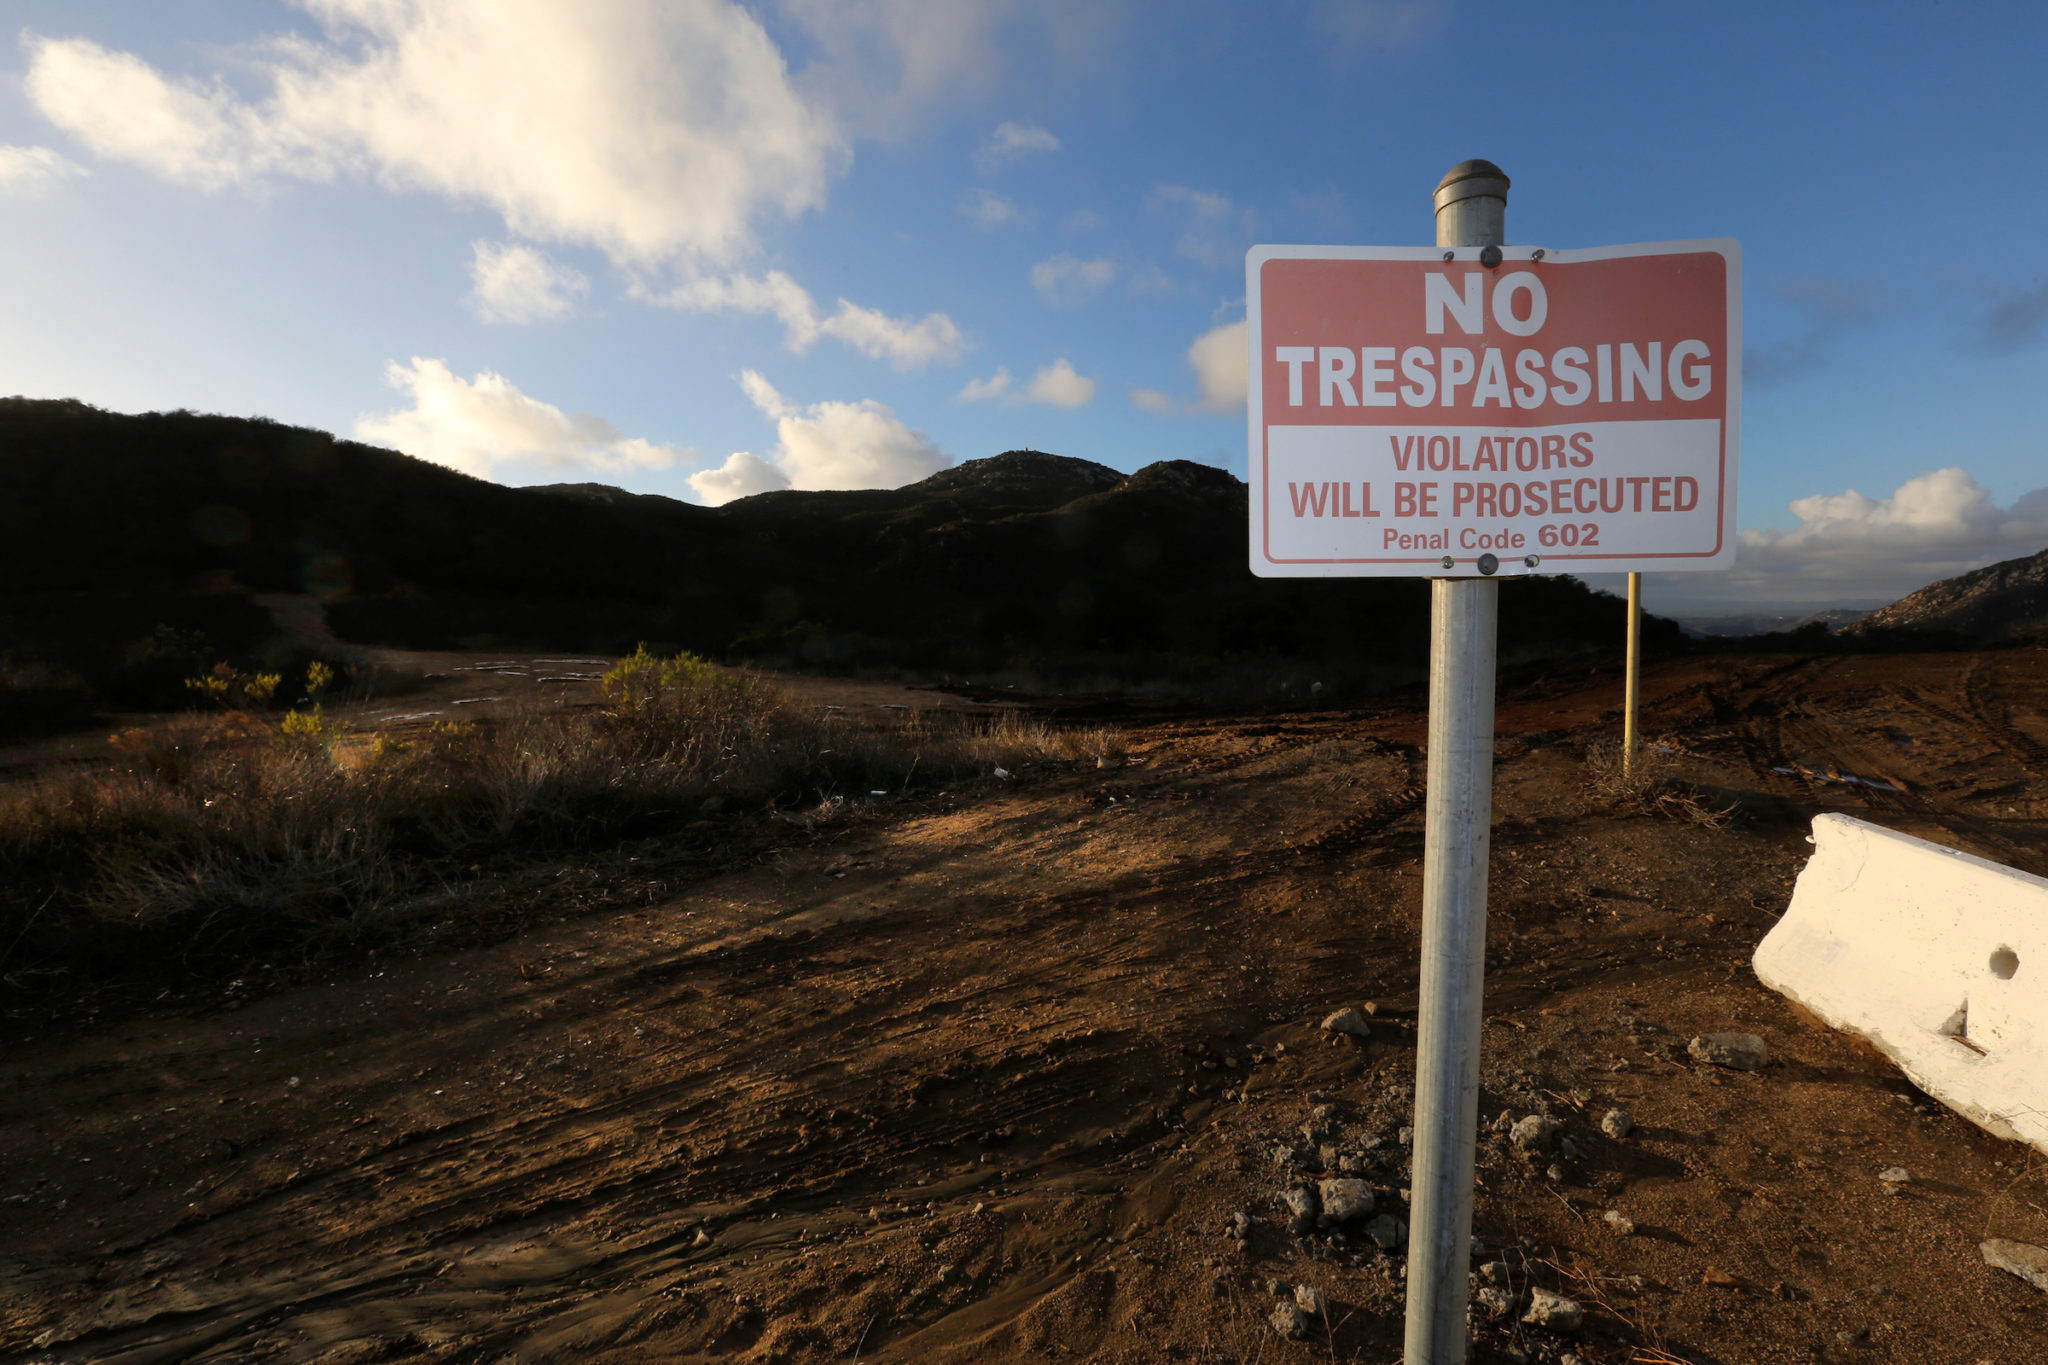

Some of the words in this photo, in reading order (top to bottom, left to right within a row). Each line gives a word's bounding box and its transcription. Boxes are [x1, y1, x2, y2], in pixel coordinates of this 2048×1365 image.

[1425, 271, 1548, 337] NO
[1275, 339, 1712, 410] TRESPASSING
[1390, 432, 1594, 472] VIOLATORS
[1288, 481, 1380, 518] WILL
[1394, 482, 1438, 518] BE
[1453, 476, 1699, 518] PROSECUTED
[1383, 528, 1449, 550] Penal
[1459, 527, 1525, 550] Code
[1539, 523, 1600, 547] 602
